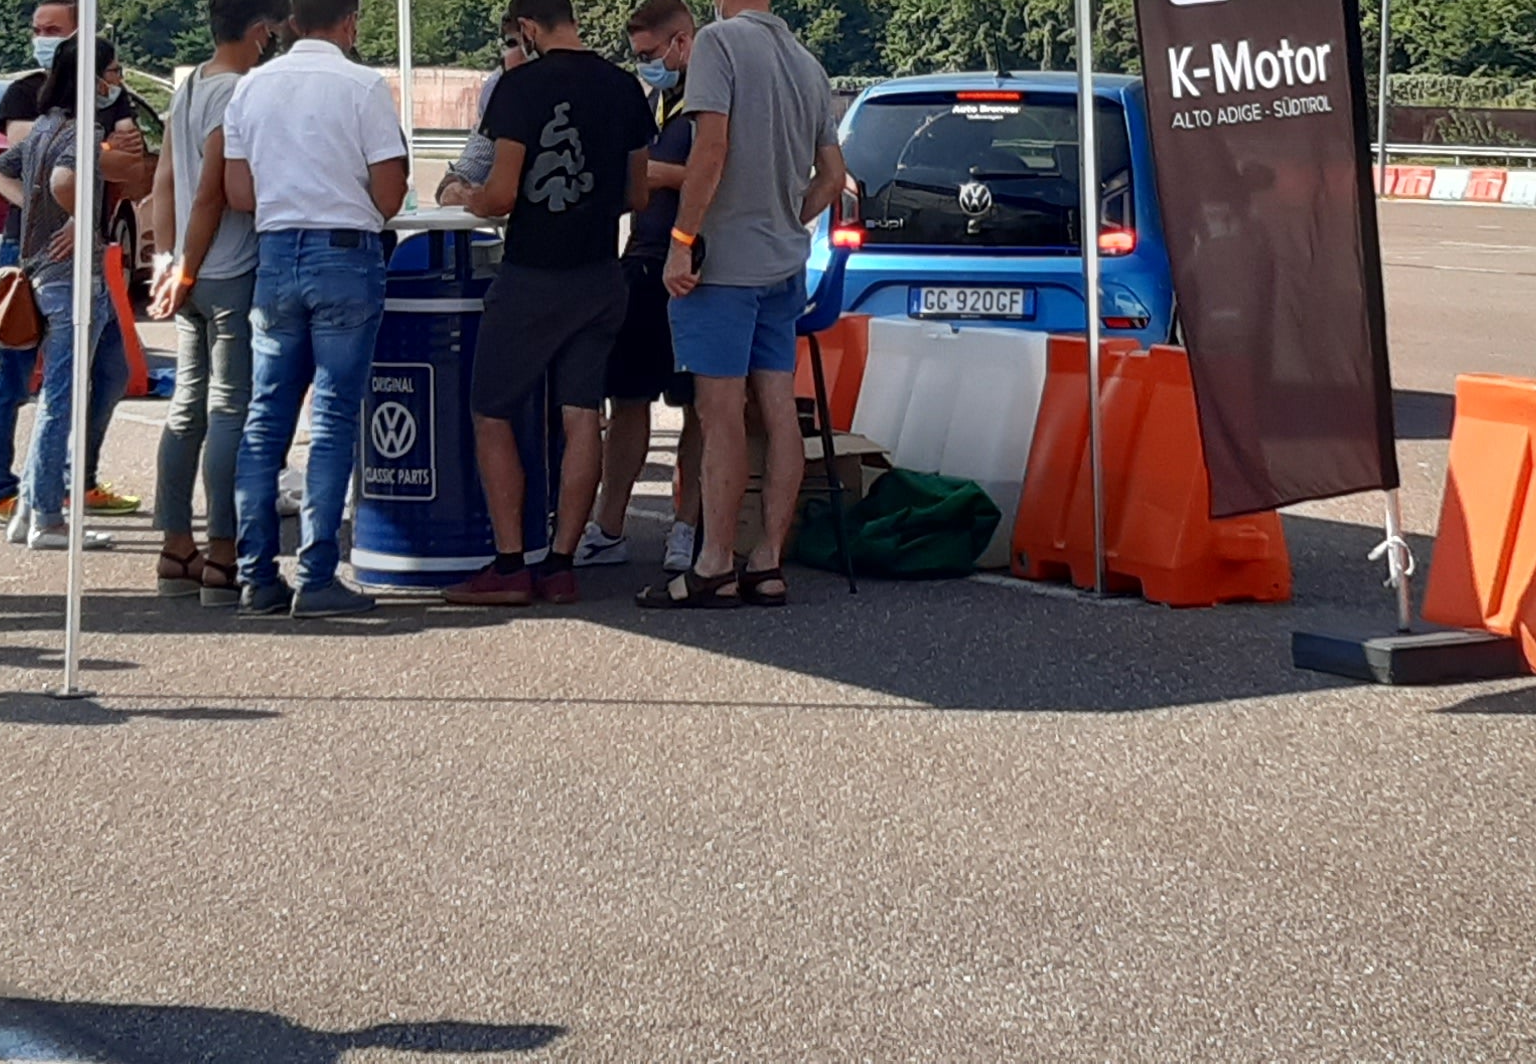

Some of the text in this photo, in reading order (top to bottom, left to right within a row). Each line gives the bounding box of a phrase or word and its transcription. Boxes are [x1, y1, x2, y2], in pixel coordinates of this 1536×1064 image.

[1168, 39, 1331, 98] K-Motor
[952, 104, 978, 114] Auto
[1172, 109, 1212, 129] ALTO
[1217, 104, 1262, 126] ADIGE
[1273, 96, 1332, 118] SÜDTIROL
[372, 376, 414, 393] ORIGINAL
[365, 467, 430, 485] CLASSIC PARTS
